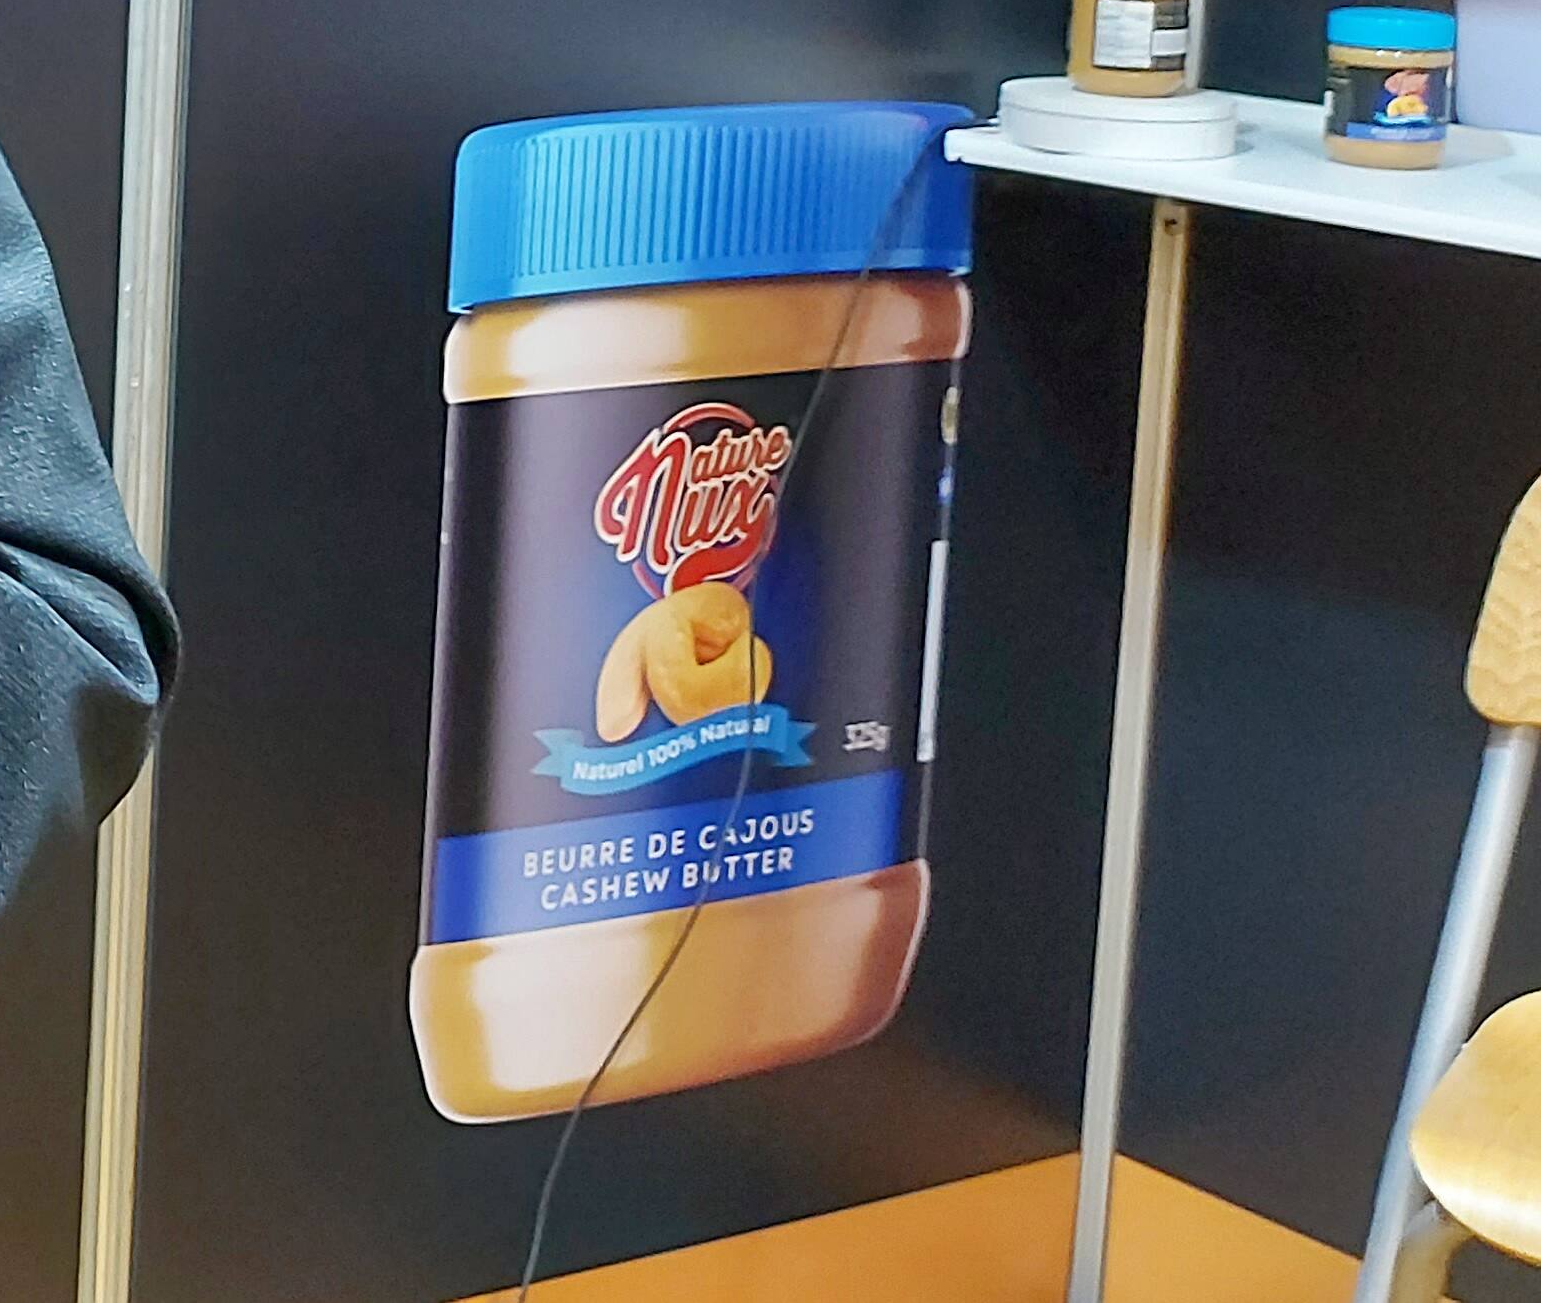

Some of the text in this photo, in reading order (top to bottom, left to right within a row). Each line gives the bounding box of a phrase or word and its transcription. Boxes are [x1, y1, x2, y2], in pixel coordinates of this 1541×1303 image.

[572, 714, 771, 783] Naturel 100% Natual
[523, 838, 634, 877] BEURRE
[647, 830, 686, 859] DE
[540, 846, 795, 912] CASHEW BUTTER
